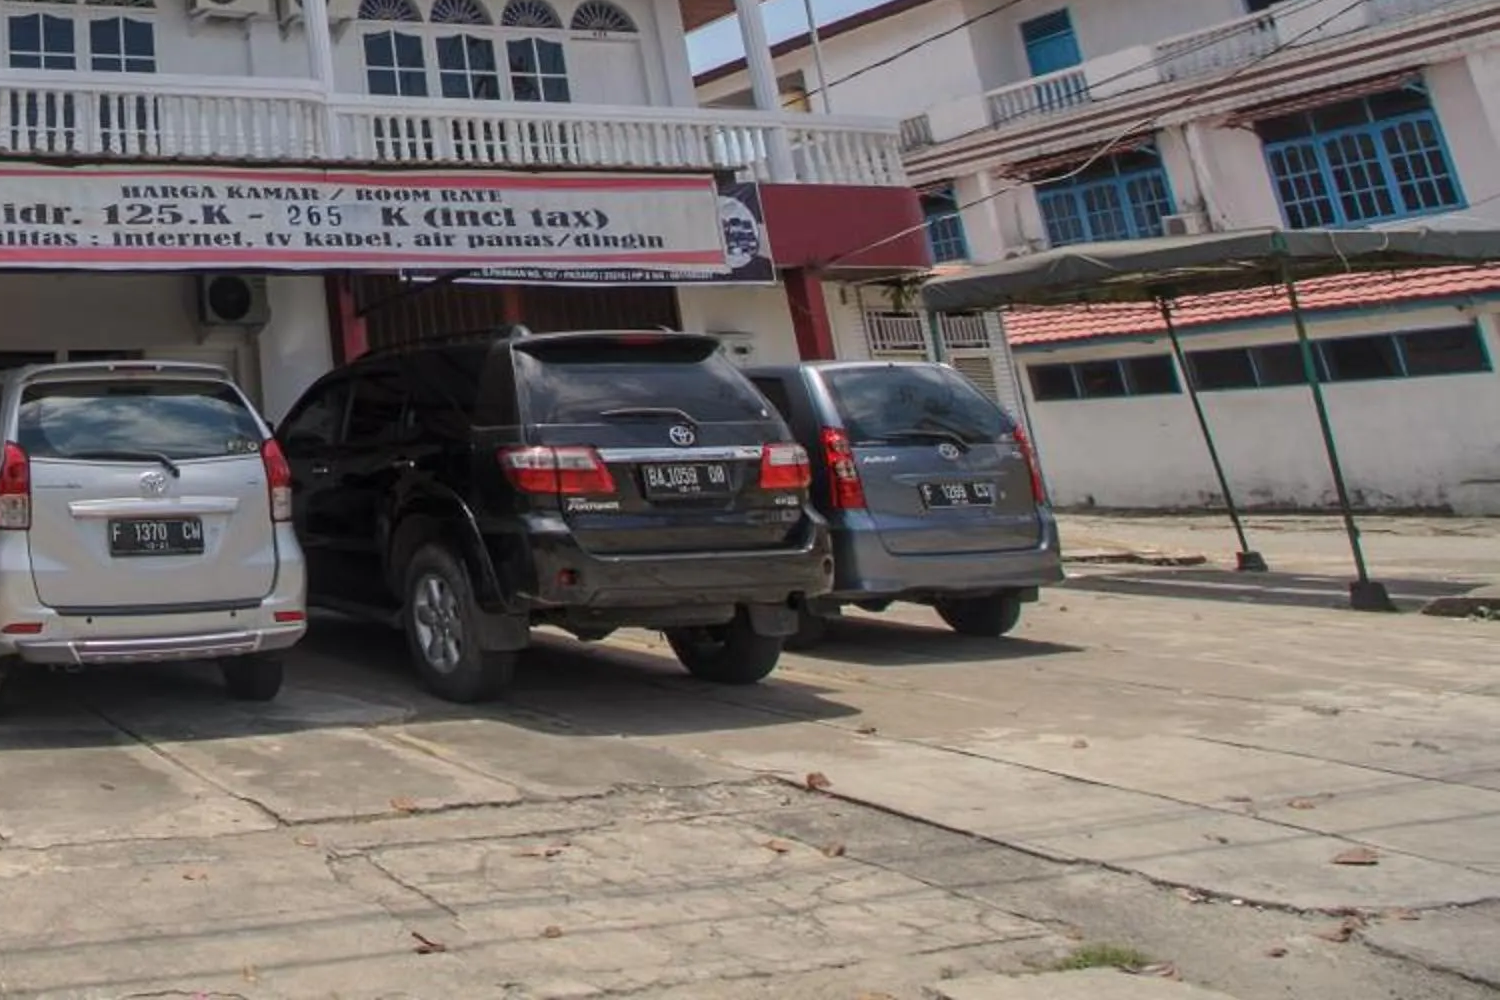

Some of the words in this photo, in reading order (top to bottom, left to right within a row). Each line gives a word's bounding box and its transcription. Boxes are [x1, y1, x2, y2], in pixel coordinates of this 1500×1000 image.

[120, 185, 217, 199] HARGA
[226, 187, 320, 201] KAMAR
[355, 188, 431, 202] ROOM
[440, 189, 502, 203] RATE
[2, 203, 82, 225] idr.
[101, 203, 232, 226] 125.K
[287, 204, 343, 227] 265
[423, 207, 517, 229] (incl
[528, 208, 609, 230] tax)
[265, 231, 292, 247] tv
[413, 231, 457, 247] air
[112, 524, 122, 541] F
